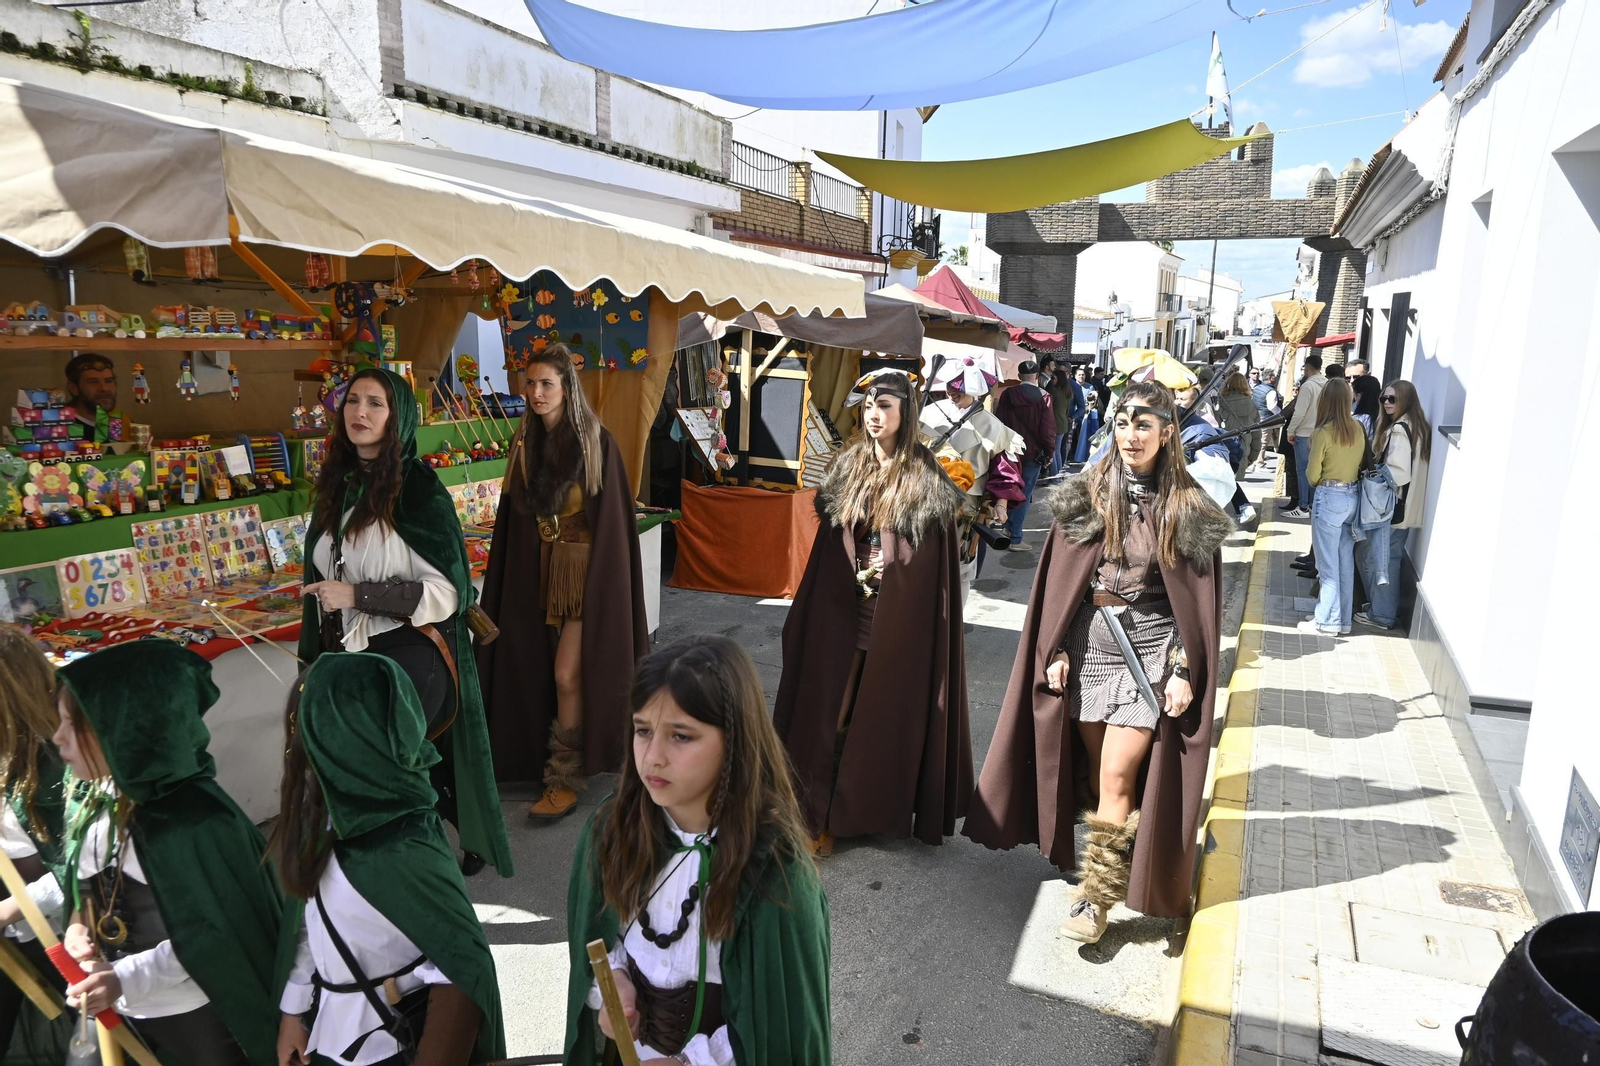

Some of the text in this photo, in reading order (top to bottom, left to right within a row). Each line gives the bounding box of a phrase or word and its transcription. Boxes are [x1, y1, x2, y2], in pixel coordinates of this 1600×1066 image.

[134, 526, 144, 537] A
[148, 524, 157, 534] B
[162, 521, 170, 531] C
[174, 519, 183, 530] D
[148, 536, 159, 547] G
[164, 533, 174, 544] H
[177, 531, 186, 542] I
[139, 550, 148, 562] K
[151, 549, 160, 560] L
[163, 546, 174, 558] M
[177, 543, 188, 554] N
[160, 561, 168, 572] P
[176, 557, 187, 567] Q
[192, 554, 201, 565] R
[159, 573, 168, 585] T
[174, 570, 183, 581] U
[190, 567, 198, 578] V
[167, 584, 177, 595] X
[184, 580, 192, 591] Y
[197, 578, 206, 589] Z
